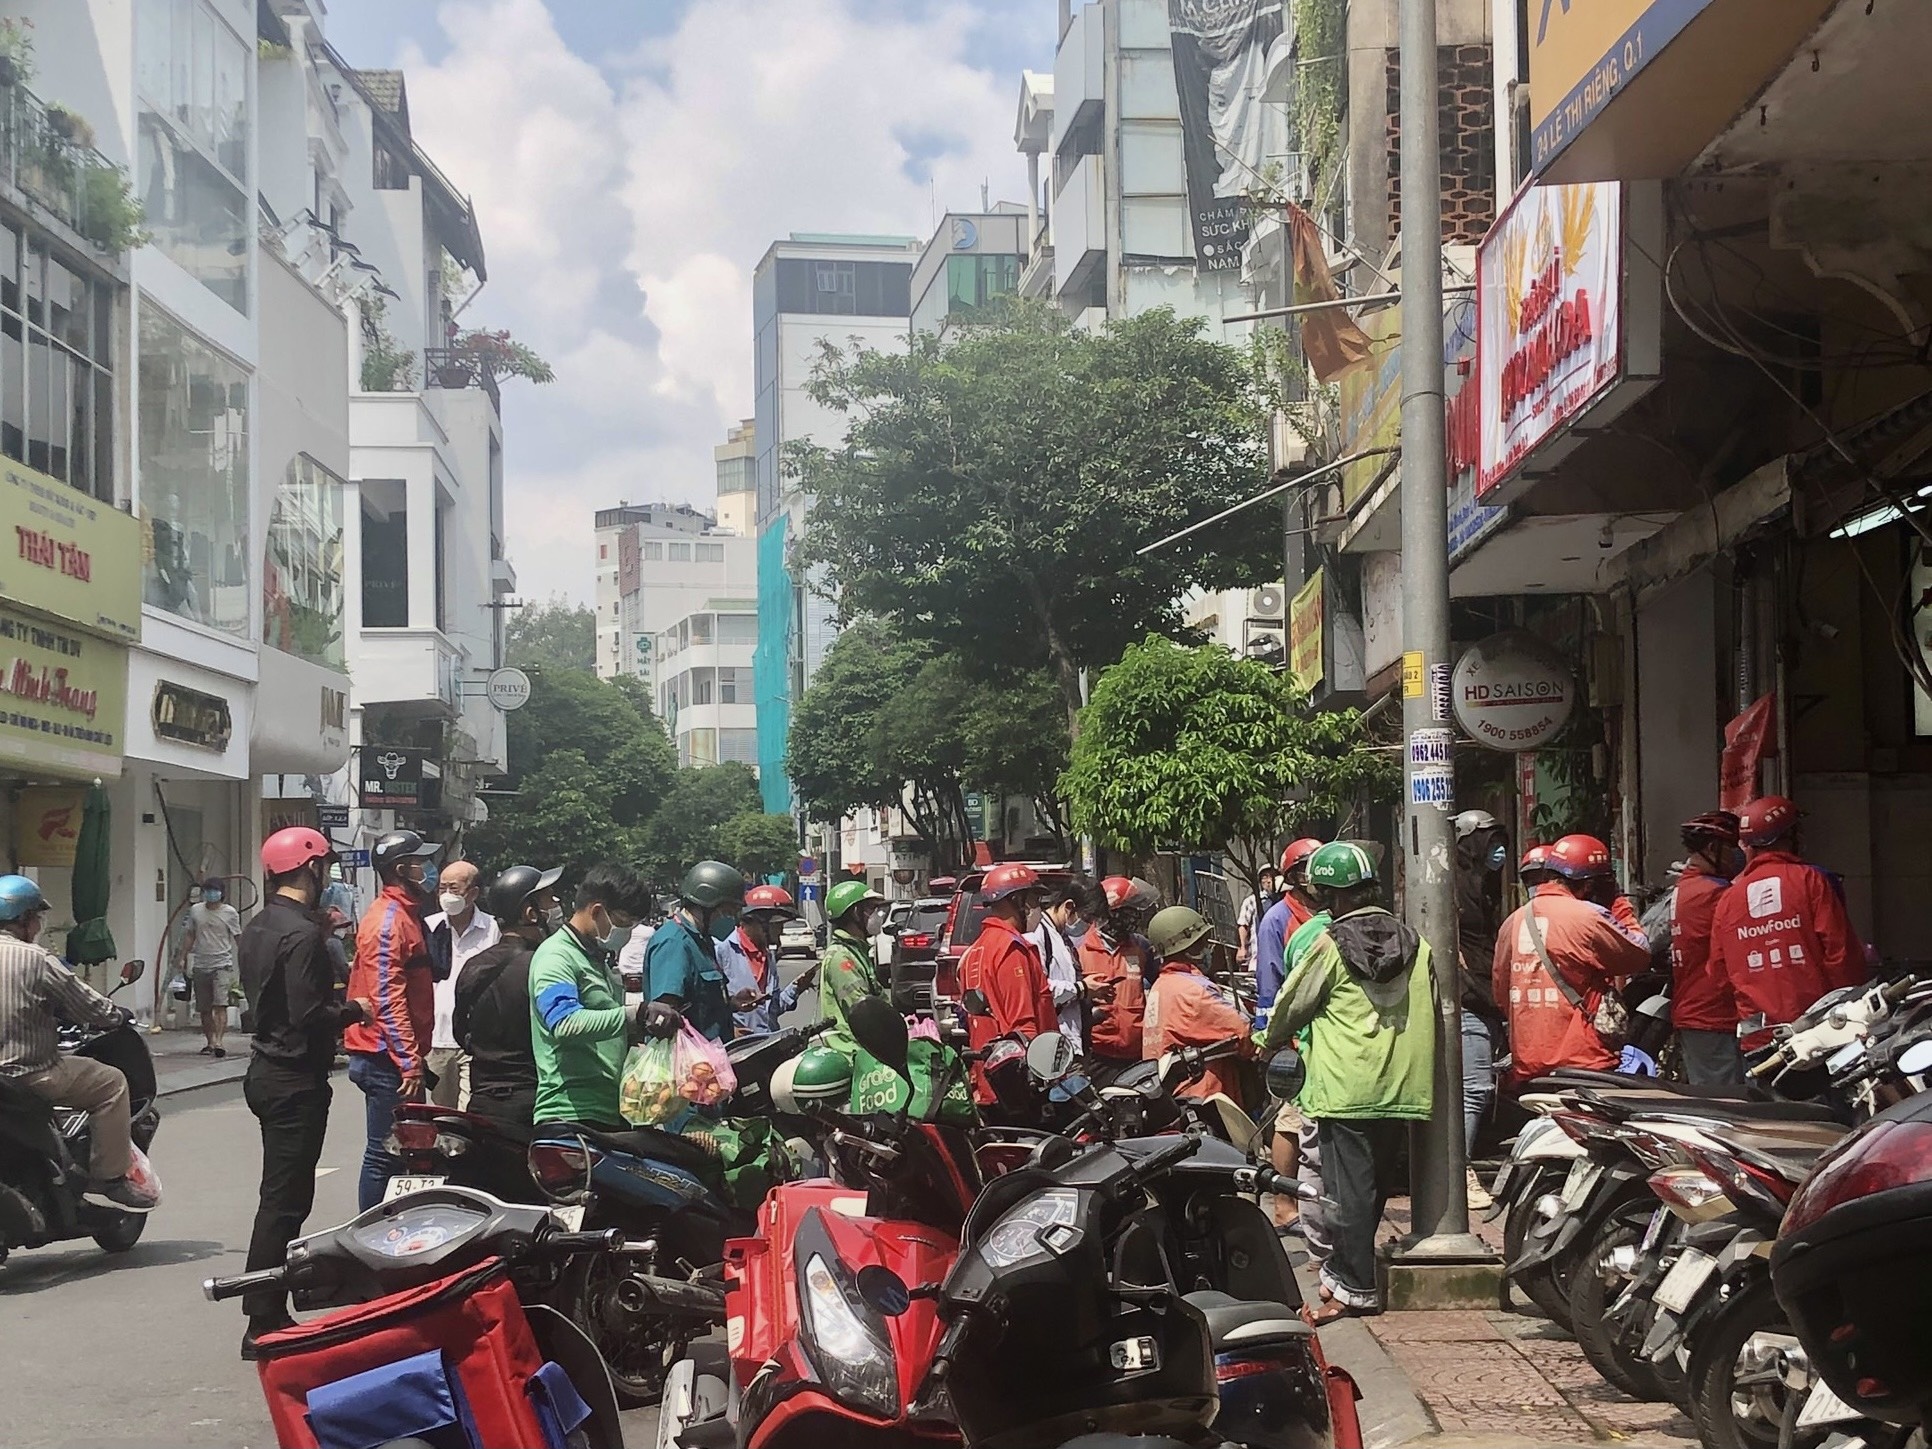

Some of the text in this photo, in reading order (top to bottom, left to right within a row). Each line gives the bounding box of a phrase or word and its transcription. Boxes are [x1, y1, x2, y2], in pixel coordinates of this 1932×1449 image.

[1550, 109, 1563, 149] LÊ
[1565, 94, 1582, 133] THỊ
[1624, 30, 1642, 71] Q.1
[1202, 222, 1230, 237] SỨC
[1208, 256, 1240, 270] NAM
[1465, 681, 1564, 701] HD SAISON
[1478, 716, 1553, 740] 1900 558854
[364, 780, 384, 793] MR.
[1314, 864, 1335, 876] Grab
[859, 1064, 897, 1093] Grab
[859, 1081, 897, 1115] Food
